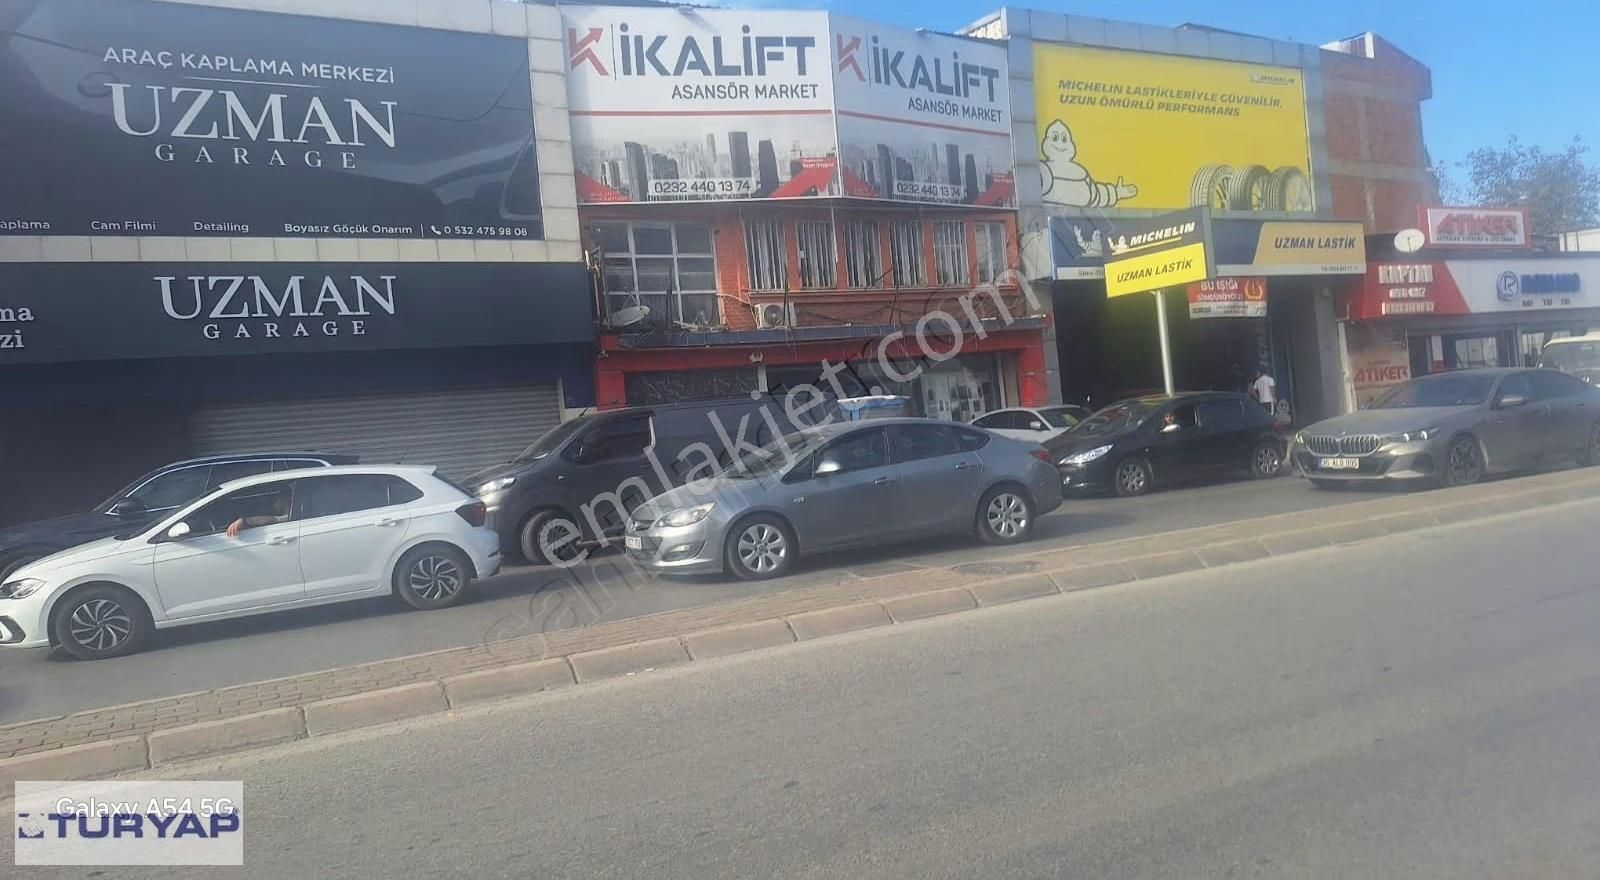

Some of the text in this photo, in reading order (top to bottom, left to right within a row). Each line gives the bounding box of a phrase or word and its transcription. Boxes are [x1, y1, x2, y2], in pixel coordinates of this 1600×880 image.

[619, 23, 815, 76] İKALİFT
[103, 46, 395, 84] ARAÇ KAPLAMA MERKEZİ
[871, 36, 999, 102] İKALİFT
[671, 83, 819, 100] ASANSÖR MARKET
[1058, 79, 1283, 109] MICHELIN LASTİKLERİYLE GÜVENİLİR,
[103, 82, 398, 149] UZMAN
[908, 97, 1003, 124] ASANSÖR MARKET
[1059, 94, 1240, 117] UZUN ÖMÜRLÜ PERFORMANS
[154, 143, 356, 169] GARAGE
[654, 180, 751, 194] 0232 440 13 74
[897, 182, 921, 195] 0232
[91, 220, 156, 231] Cam Filmi
[193, 221, 249, 233] Detailing
[284, 222, 413, 236] Boyasız Göçük Onarım
[454, 225, 474, 235] 532
[476, 226, 496, 236] 475
[1130, 221, 1196, 248] MICHELIN
[1274, 234, 1357, 250] UZMAN LASTİK
[1117, 267, 1153, 283] UZMAN
[1154, 258, 1193, 276] LASTİK
[153, 275, 397, 320] UZMAN
[203, 321, 365, 338] GARAGE
